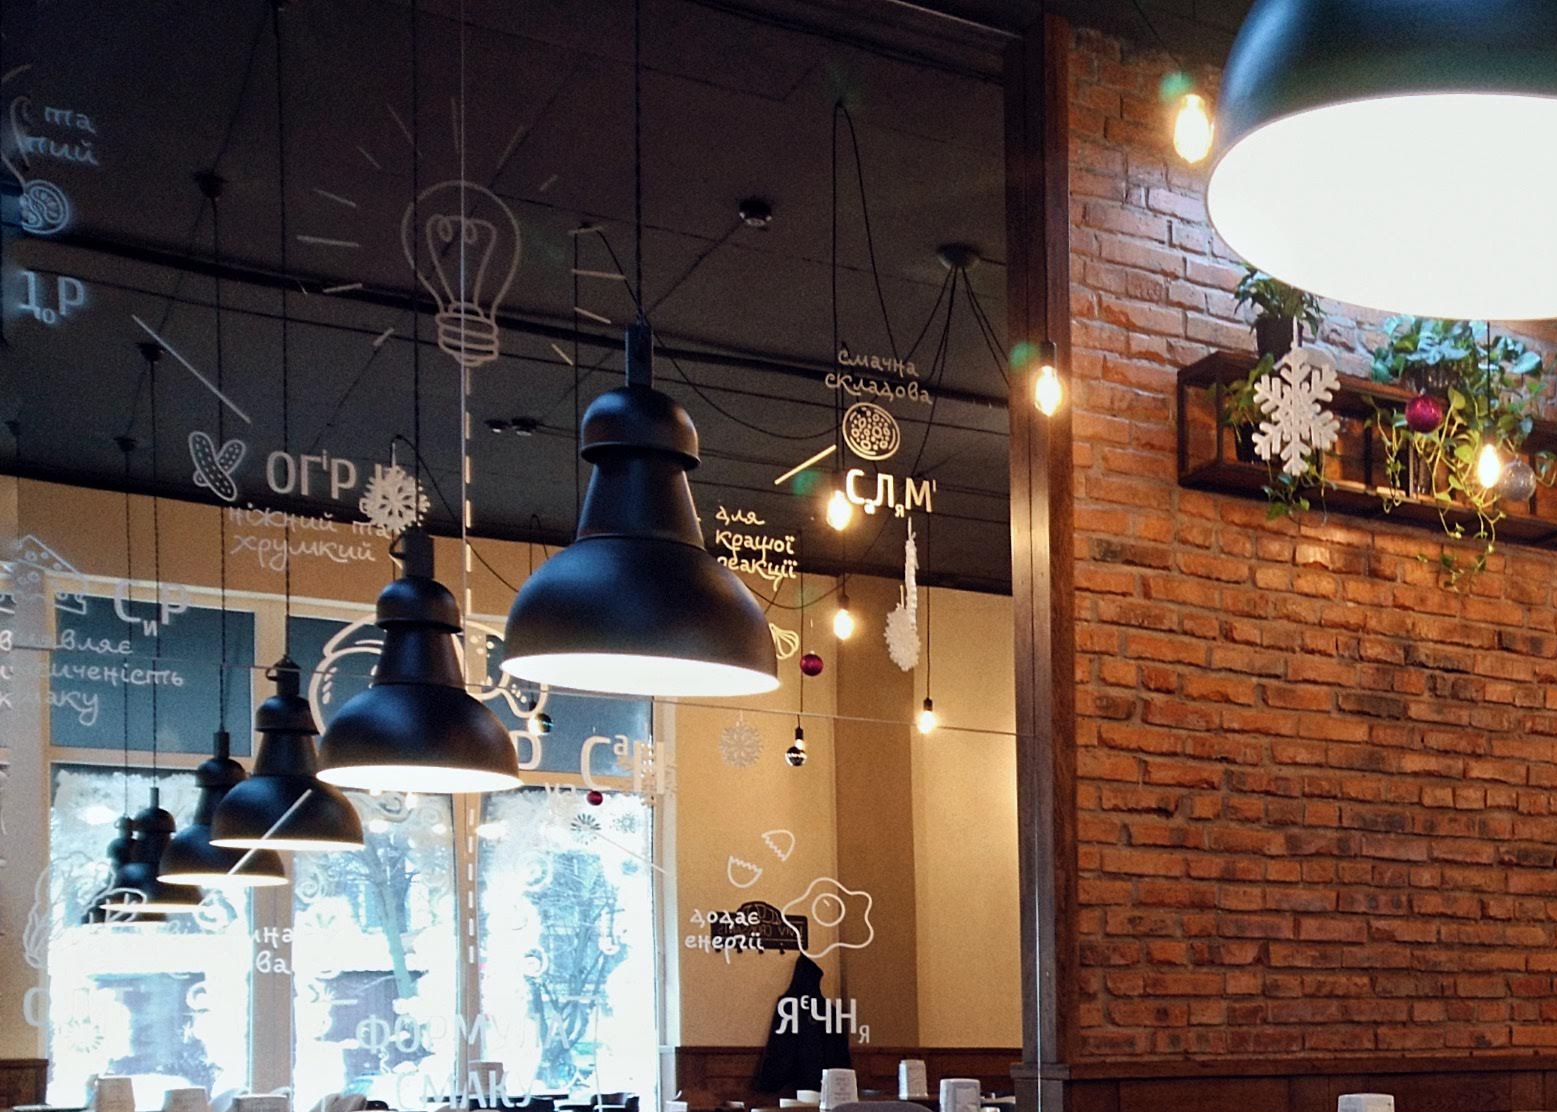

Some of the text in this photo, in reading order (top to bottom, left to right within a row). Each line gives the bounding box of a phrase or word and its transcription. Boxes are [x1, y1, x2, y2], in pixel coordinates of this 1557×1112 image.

[715, 505, 766, 527] для
[229, 533, 377, 571] хрумкий
[715, 529, 796, 563] кращої
[689, 907, 761, 929] додає
[684, 932, 765, 965] енергії
